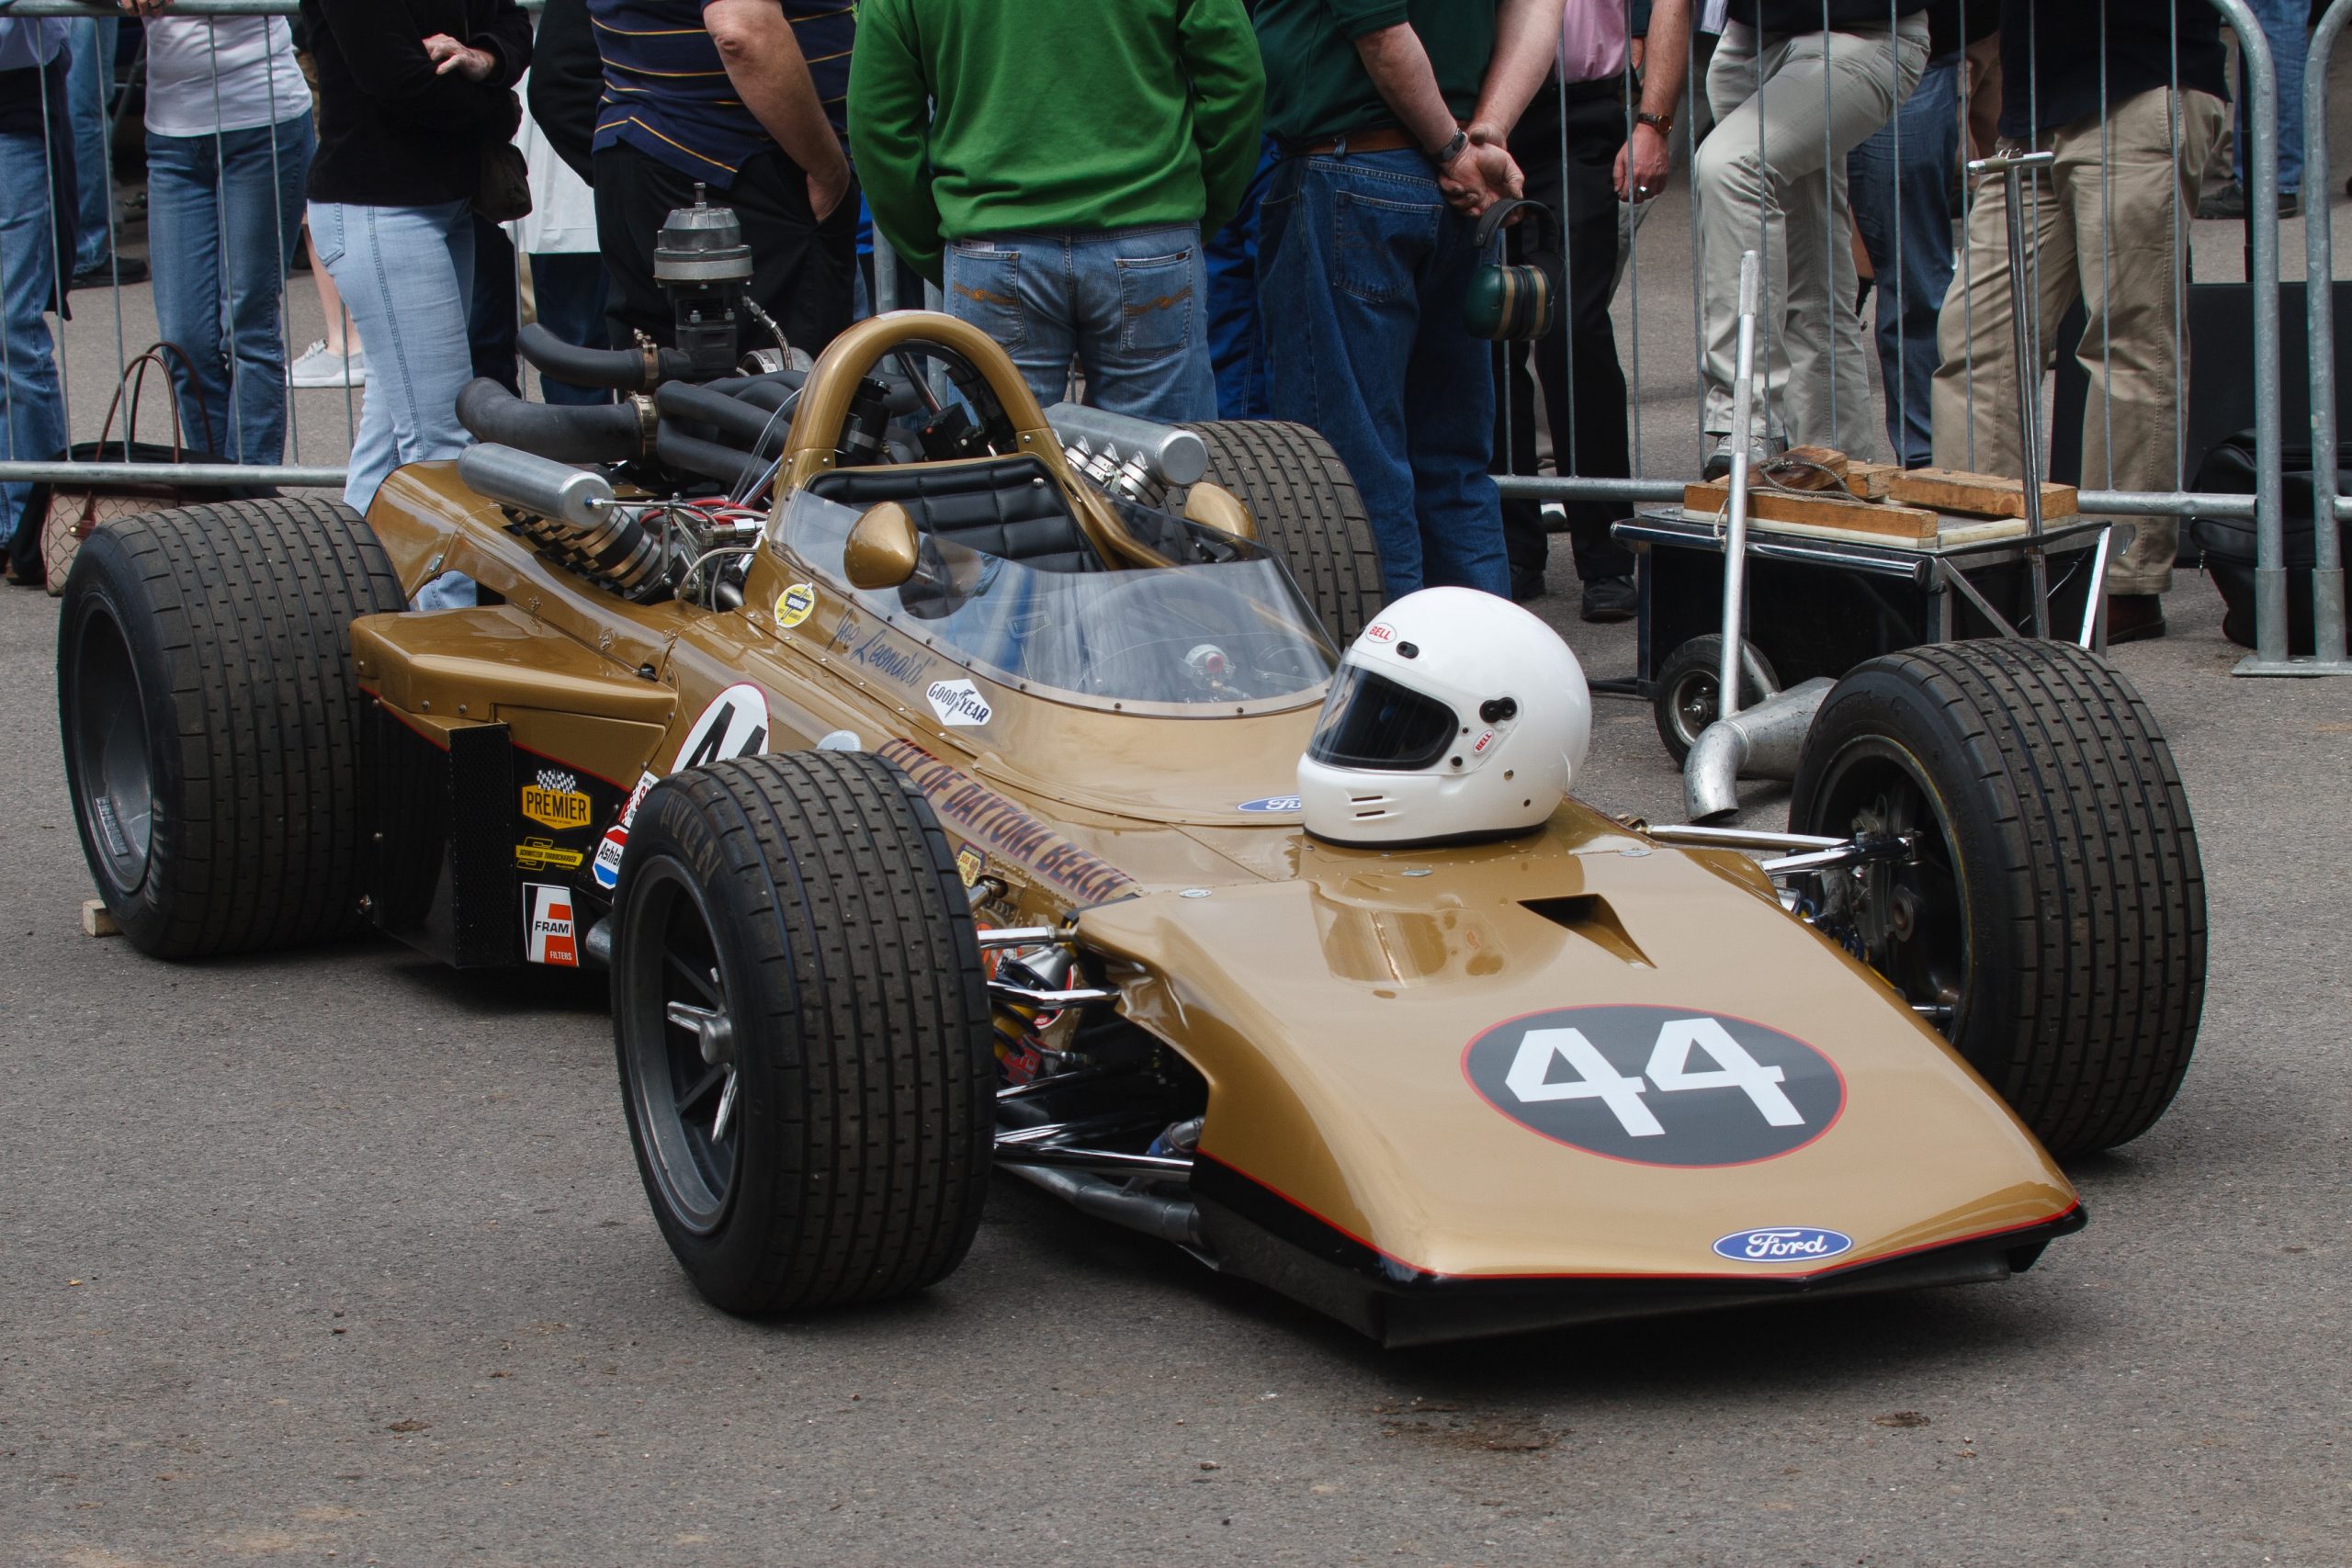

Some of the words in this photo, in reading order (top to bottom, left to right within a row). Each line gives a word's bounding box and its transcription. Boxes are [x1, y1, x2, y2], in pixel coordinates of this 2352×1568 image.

[1369, 626, 1391, 640] BELL
[1475, 733, 1492, 750] BELL
[919, 765, 967, 801] OF
[526, 790, 587, 822] PREMIER
[941, 783, 1056, 863] DAYTONA
[1035, 841, 1136, 905] BEACH
[534, 920, 570, 934] FRAM
[549, 950, 572, 961] FILTERS
[1505, 1018, 1806, 1137] 44
[1746, 1232, 1827, 1258] Ford
